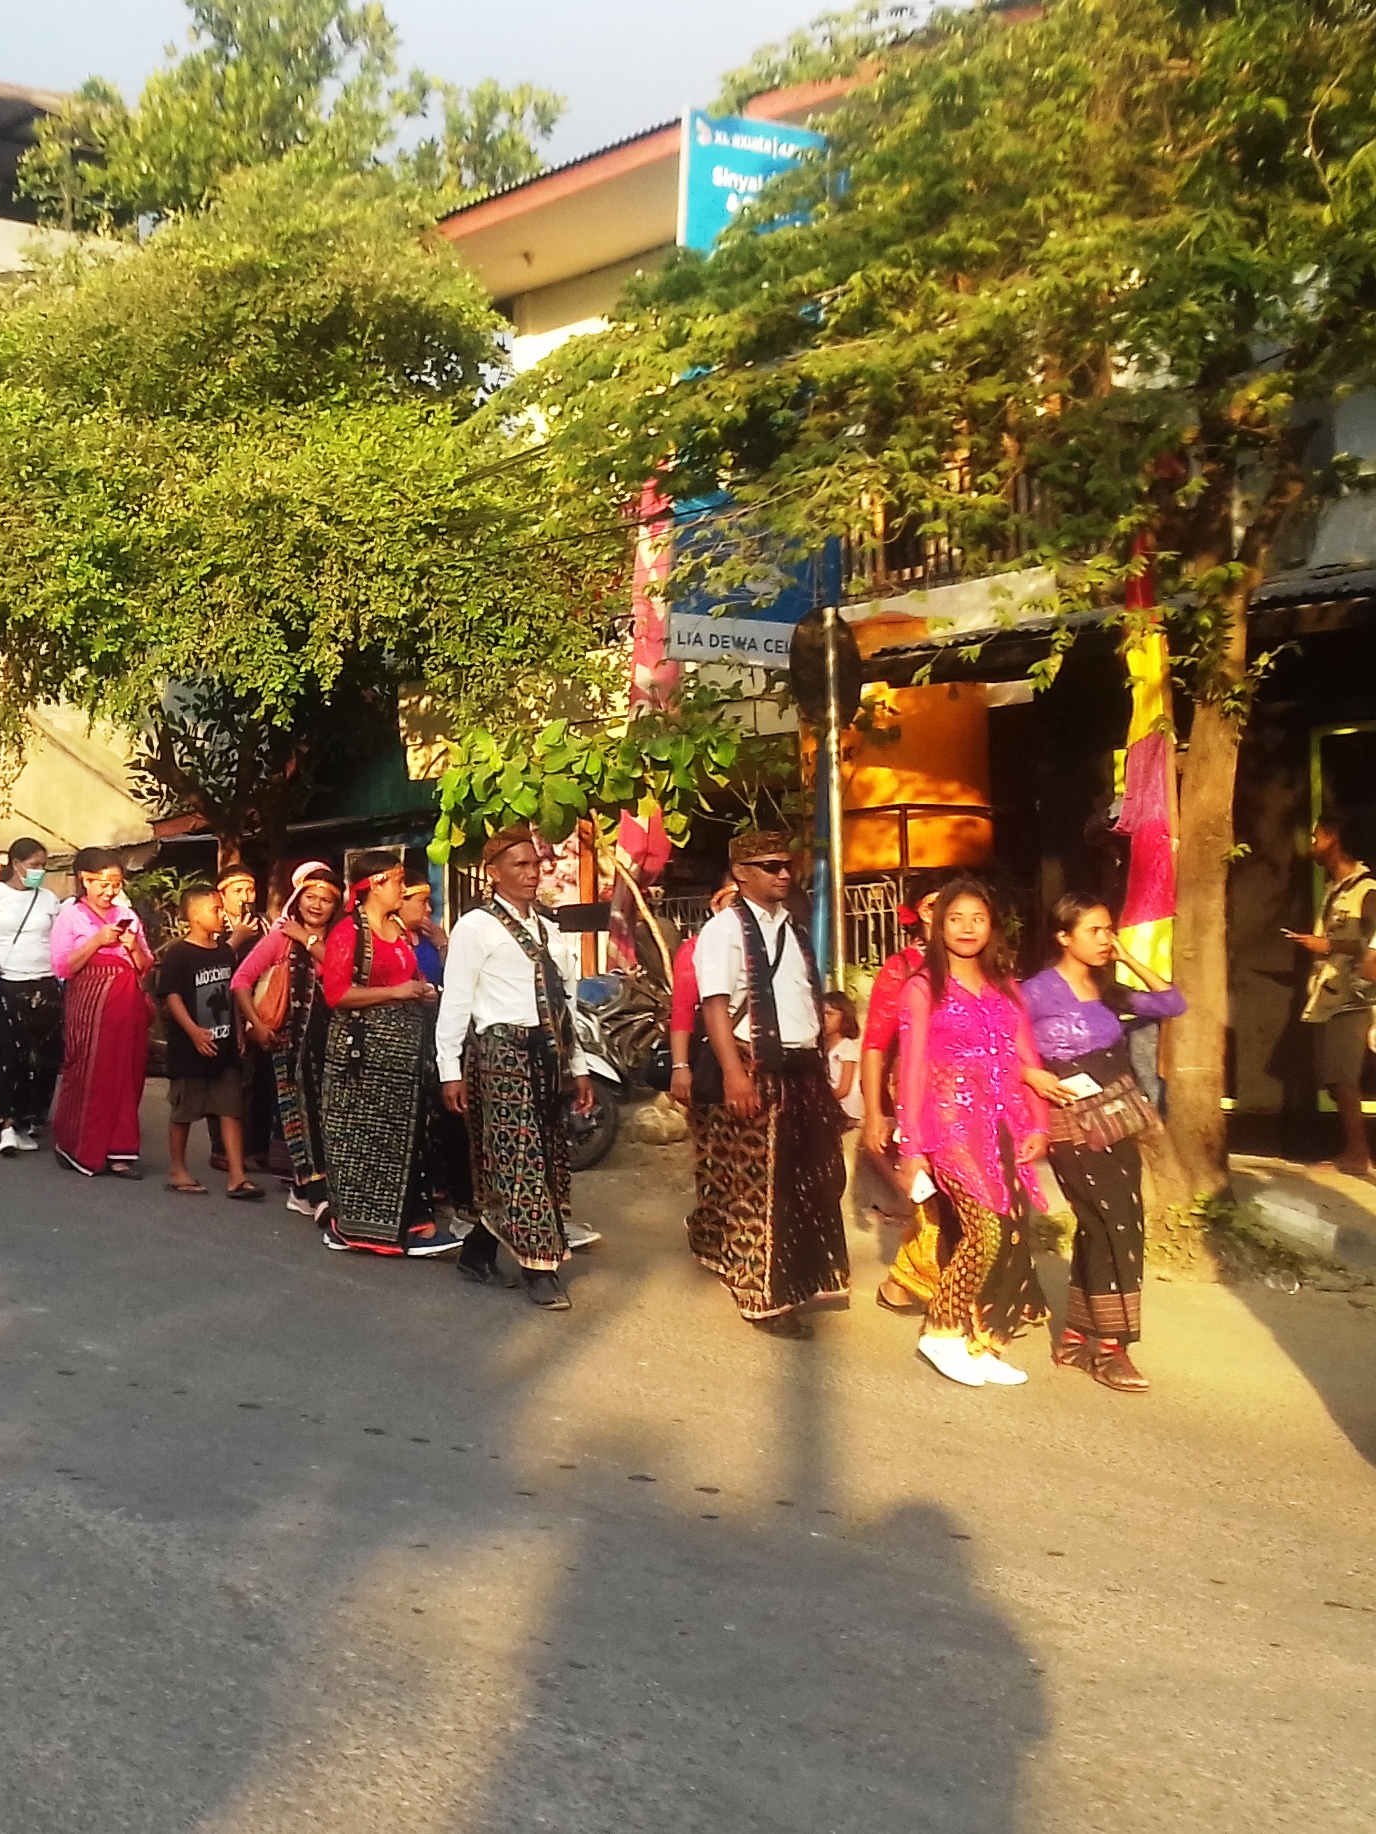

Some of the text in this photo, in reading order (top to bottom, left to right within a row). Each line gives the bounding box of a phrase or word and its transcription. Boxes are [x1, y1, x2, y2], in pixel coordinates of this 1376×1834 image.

[712, 165, 763, 194] Sinyal
[677, 630, 704, 647] LIA
[709, 633, 758, 652] DEWA
